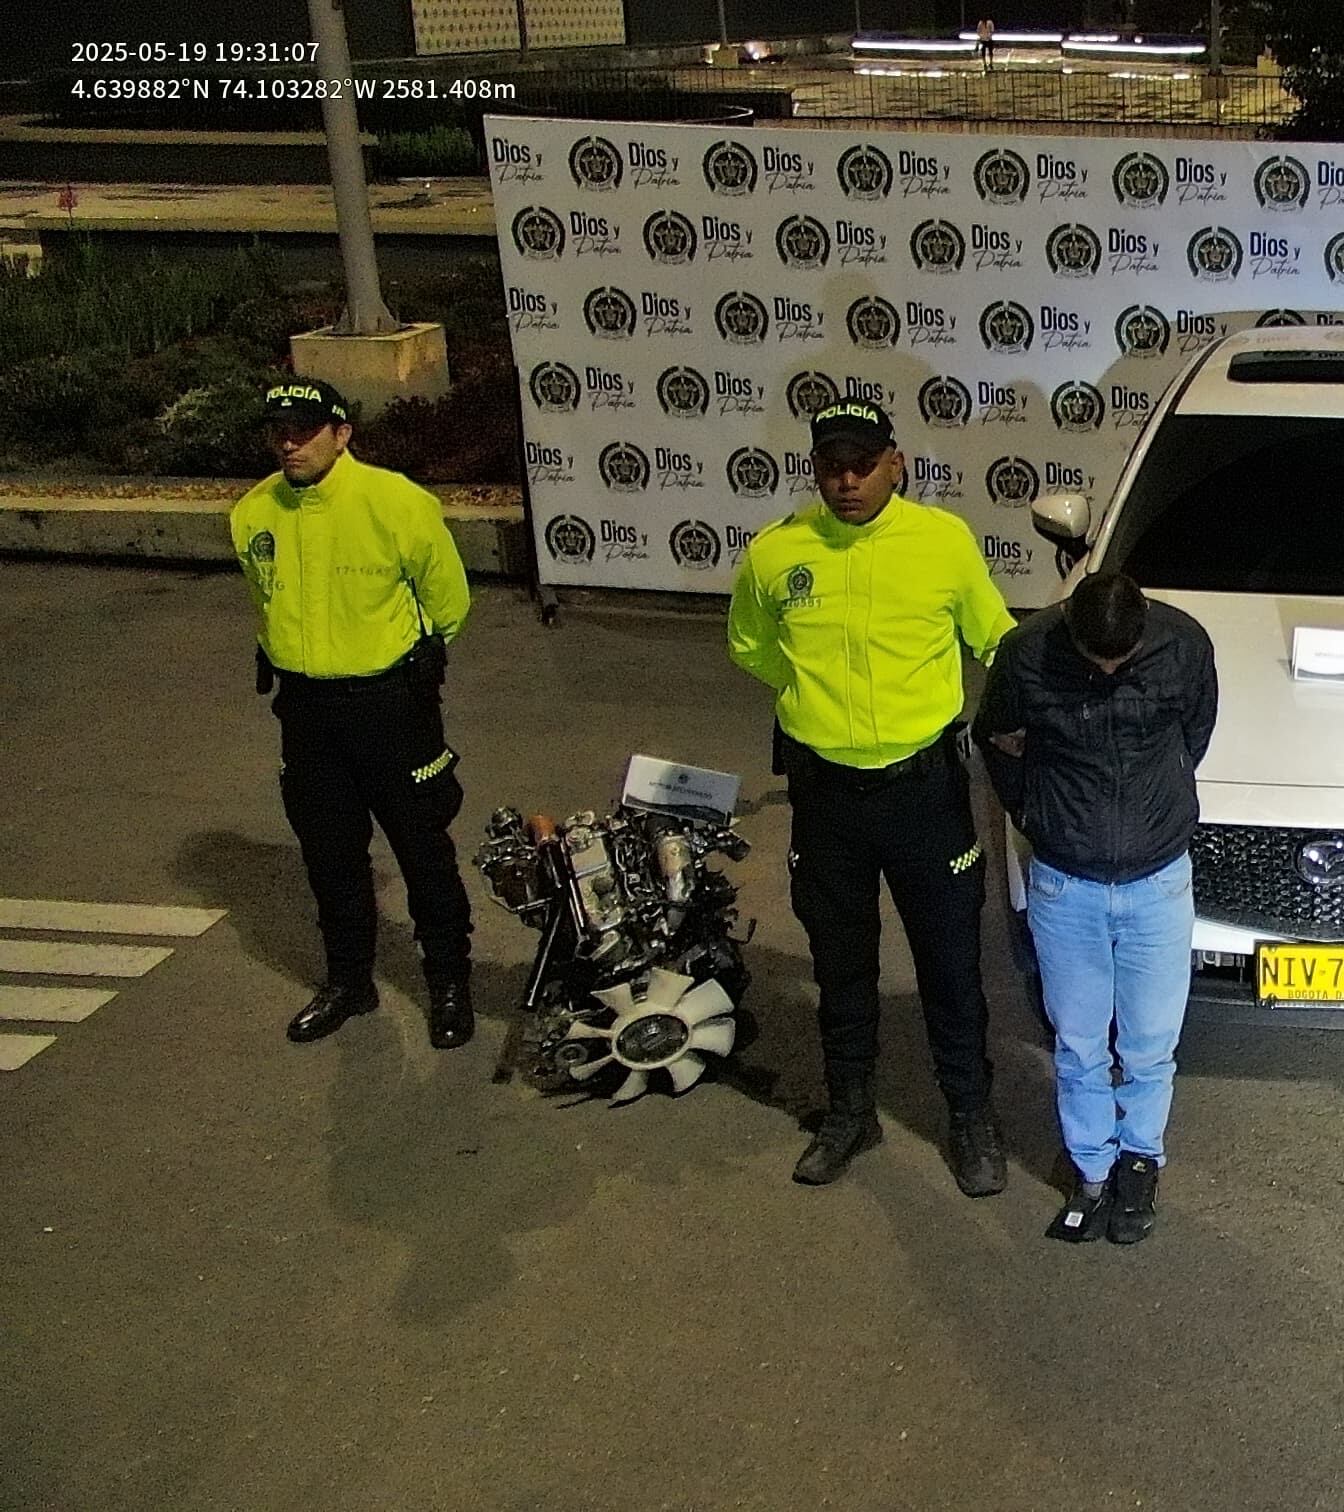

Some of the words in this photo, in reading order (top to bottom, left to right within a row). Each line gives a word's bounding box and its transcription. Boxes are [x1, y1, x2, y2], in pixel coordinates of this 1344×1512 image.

[493, 139, 531, 164] Dios
[536, 154, 542, 168] y
[629, 143, 667, 168] Dios
[672, 158, 678, 172] y
[764, 147, 802, 172] Dios
[808, 162, 814, 176] y
[900, 151, 938, 176] Dios
[944, 166, 950, 180] y
[495, 164, 544, 185] Patria
[630, 169, 680, 190] Patria
[1037, 154, 1075, 179] Dios
[1082, 170, 1088, 184] y
[1176, 158, 1215, 183] Dios
[1220, 172, 1226, 186] y
[765, 173, 815, 194] Patria
[901, 177, 951, 198] Patria
[1038, 180, 1088, 201] Patria
[1177, 184, 1227, 206] Patria
[570, 211, 607, 236] Dios
[614, 226, 620, 240] y
[702, 216, 740, 241] Dios
[746, 230, 752, 244] y
[836, 221, 874, 246] Dios
[880, 234, 886, 250] y
[571, 236, 621, 257] Patria
[703, 241, 753, 262] Patria
[1109, 228, 1147, 254] Dios
[1152, 244, 1158, 256] y
[1250, 232, 1288, 257] Dios
[1294, 248, 1300, 260] y
[837, 246, 887, 267] Patria
[1109, 254, 1159, 276] Patria
[1250, 257, 1300, 279] Patria
[509, 288, 546, 312] Dios
[550, 302, 558, 316] y
[642, 292, 679, 316] Dios
[684, 306, 690, 320] y
[774, 297, 811, 321] Dios
[818, 312, 824, 326] y
[510, 313, 559, 333] Patria
[643, 317, 692, 337] Patria
[907, 302, 945, 326] Dios
[950, 316, 956, 330] y
[1041, 306, 1079, 330] Dios
[1084, 320, 1090, 334] y
[775, 322, 824, 342] Patria
[908, 327, 957, 347] Patria
[1041, 331, 1091, 351] Patria
[586, 367, 623, 391] Dios
[628, 380, 634, 394] y
[715, 371, 752, 395] Dios
[758, 386, 764, 400] y
[587, 391, 635, 411] Patria
[716, 395, 764, 415] Patria
[979, 382, 1016, 406] Dios
[1020, 396, 1028, 410] y
[816, 403, 879, 424] POLICÍA
[979, 406, 1028, 426] Patria
[526, 442, 562, 466] Dios
[568, 456, 574, 470] y
[655, 448, 691, 471] Dios
[696, 462, 702, 474] y
[915, 458, 952, 480] Dios
[956, 472, 962, 484] y
[600, 520, 637, 543] Dios
[640, 534, 648, 546] y
[985, 536, 1022, 559] Dios
[1026, 550, 1032, 562] y
